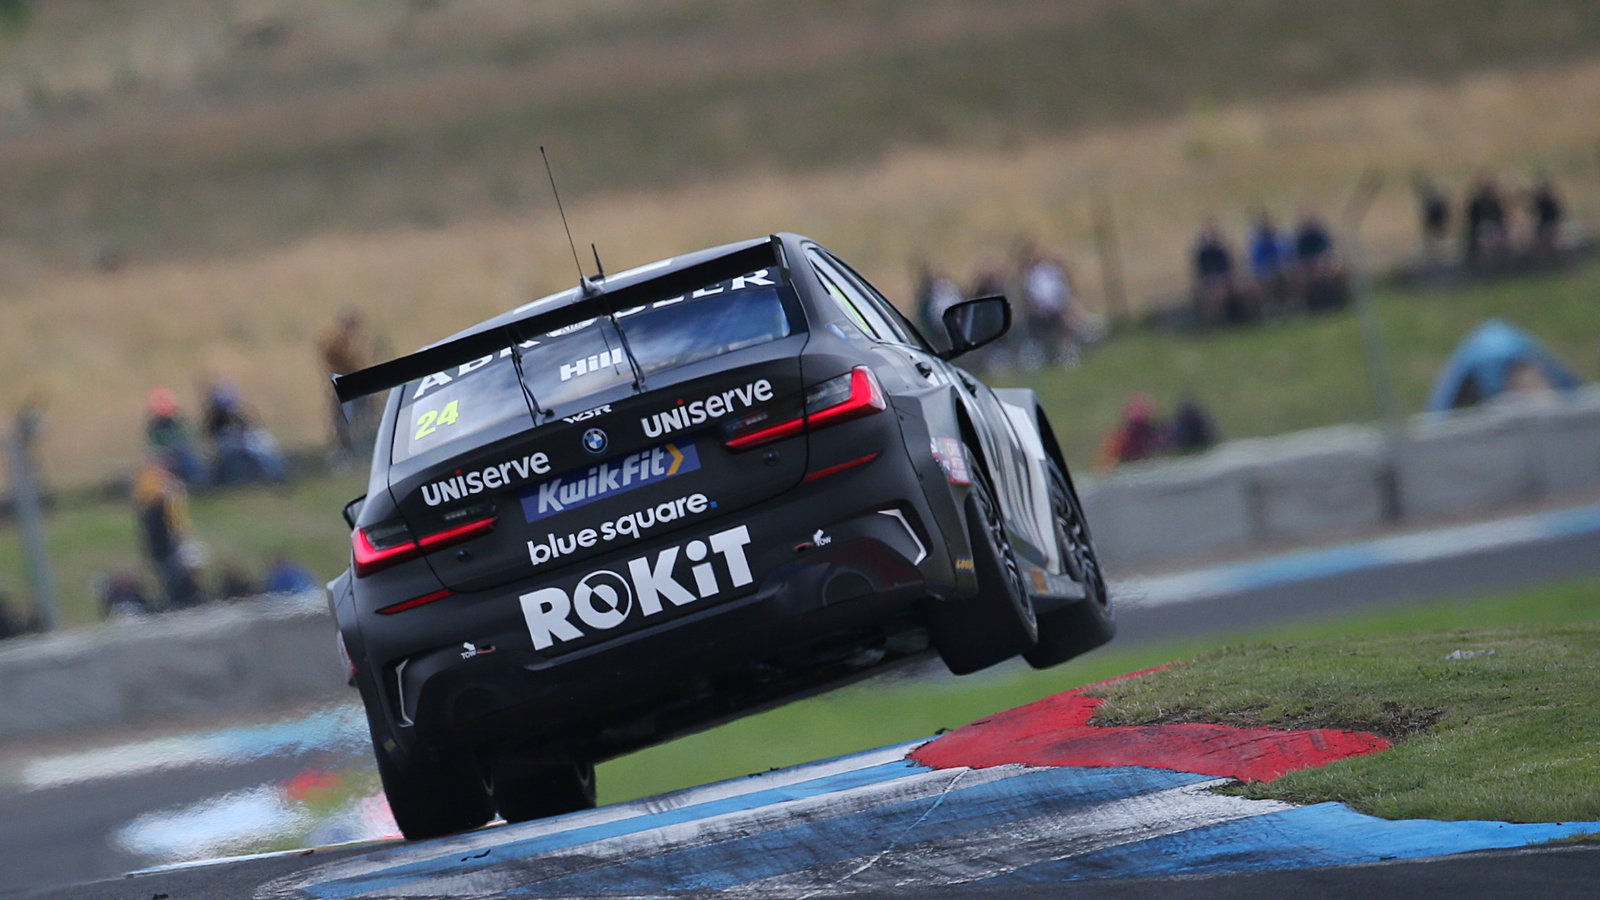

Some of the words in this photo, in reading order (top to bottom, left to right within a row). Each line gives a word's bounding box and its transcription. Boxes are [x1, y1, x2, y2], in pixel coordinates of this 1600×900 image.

[560, 348, 622, 382] Hill
[415, 399, 459, 440] 24
[562, 404, 613, 424] WSR
[527, 526, 598, 566] blue
[460, 651, 477, 659] TOW
